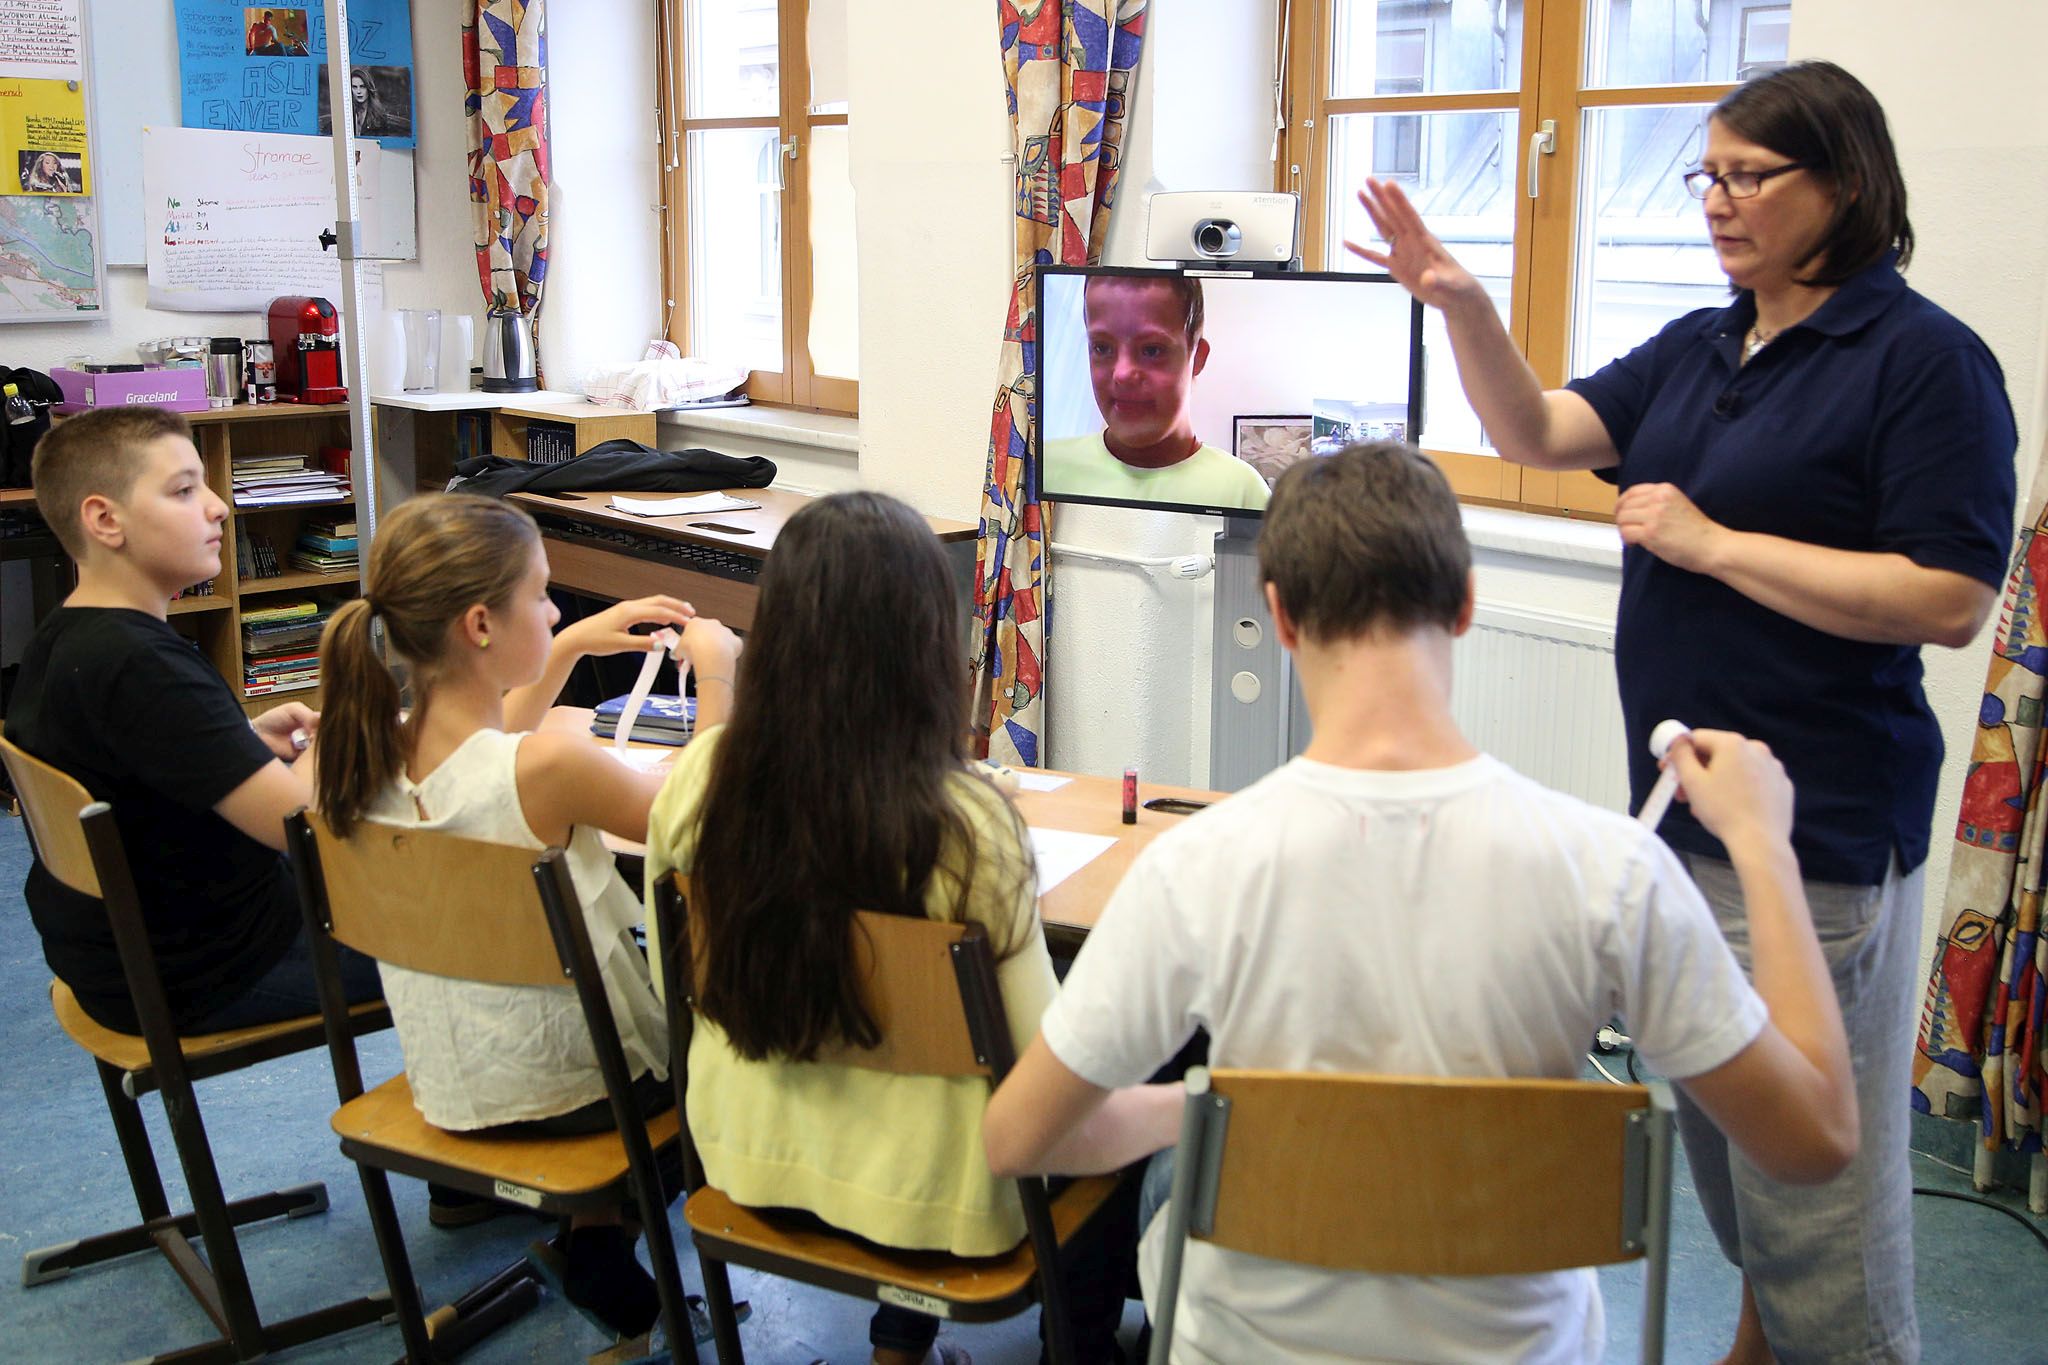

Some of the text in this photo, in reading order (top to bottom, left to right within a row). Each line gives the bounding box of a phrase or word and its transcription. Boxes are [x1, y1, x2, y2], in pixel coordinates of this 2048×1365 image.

[242, 60, 311, 99] ASLI
[201, 99, 302, 131] ENVER
[240, 143, 320, 174] Stromae
[126, 390, 178, 404] Graceland
